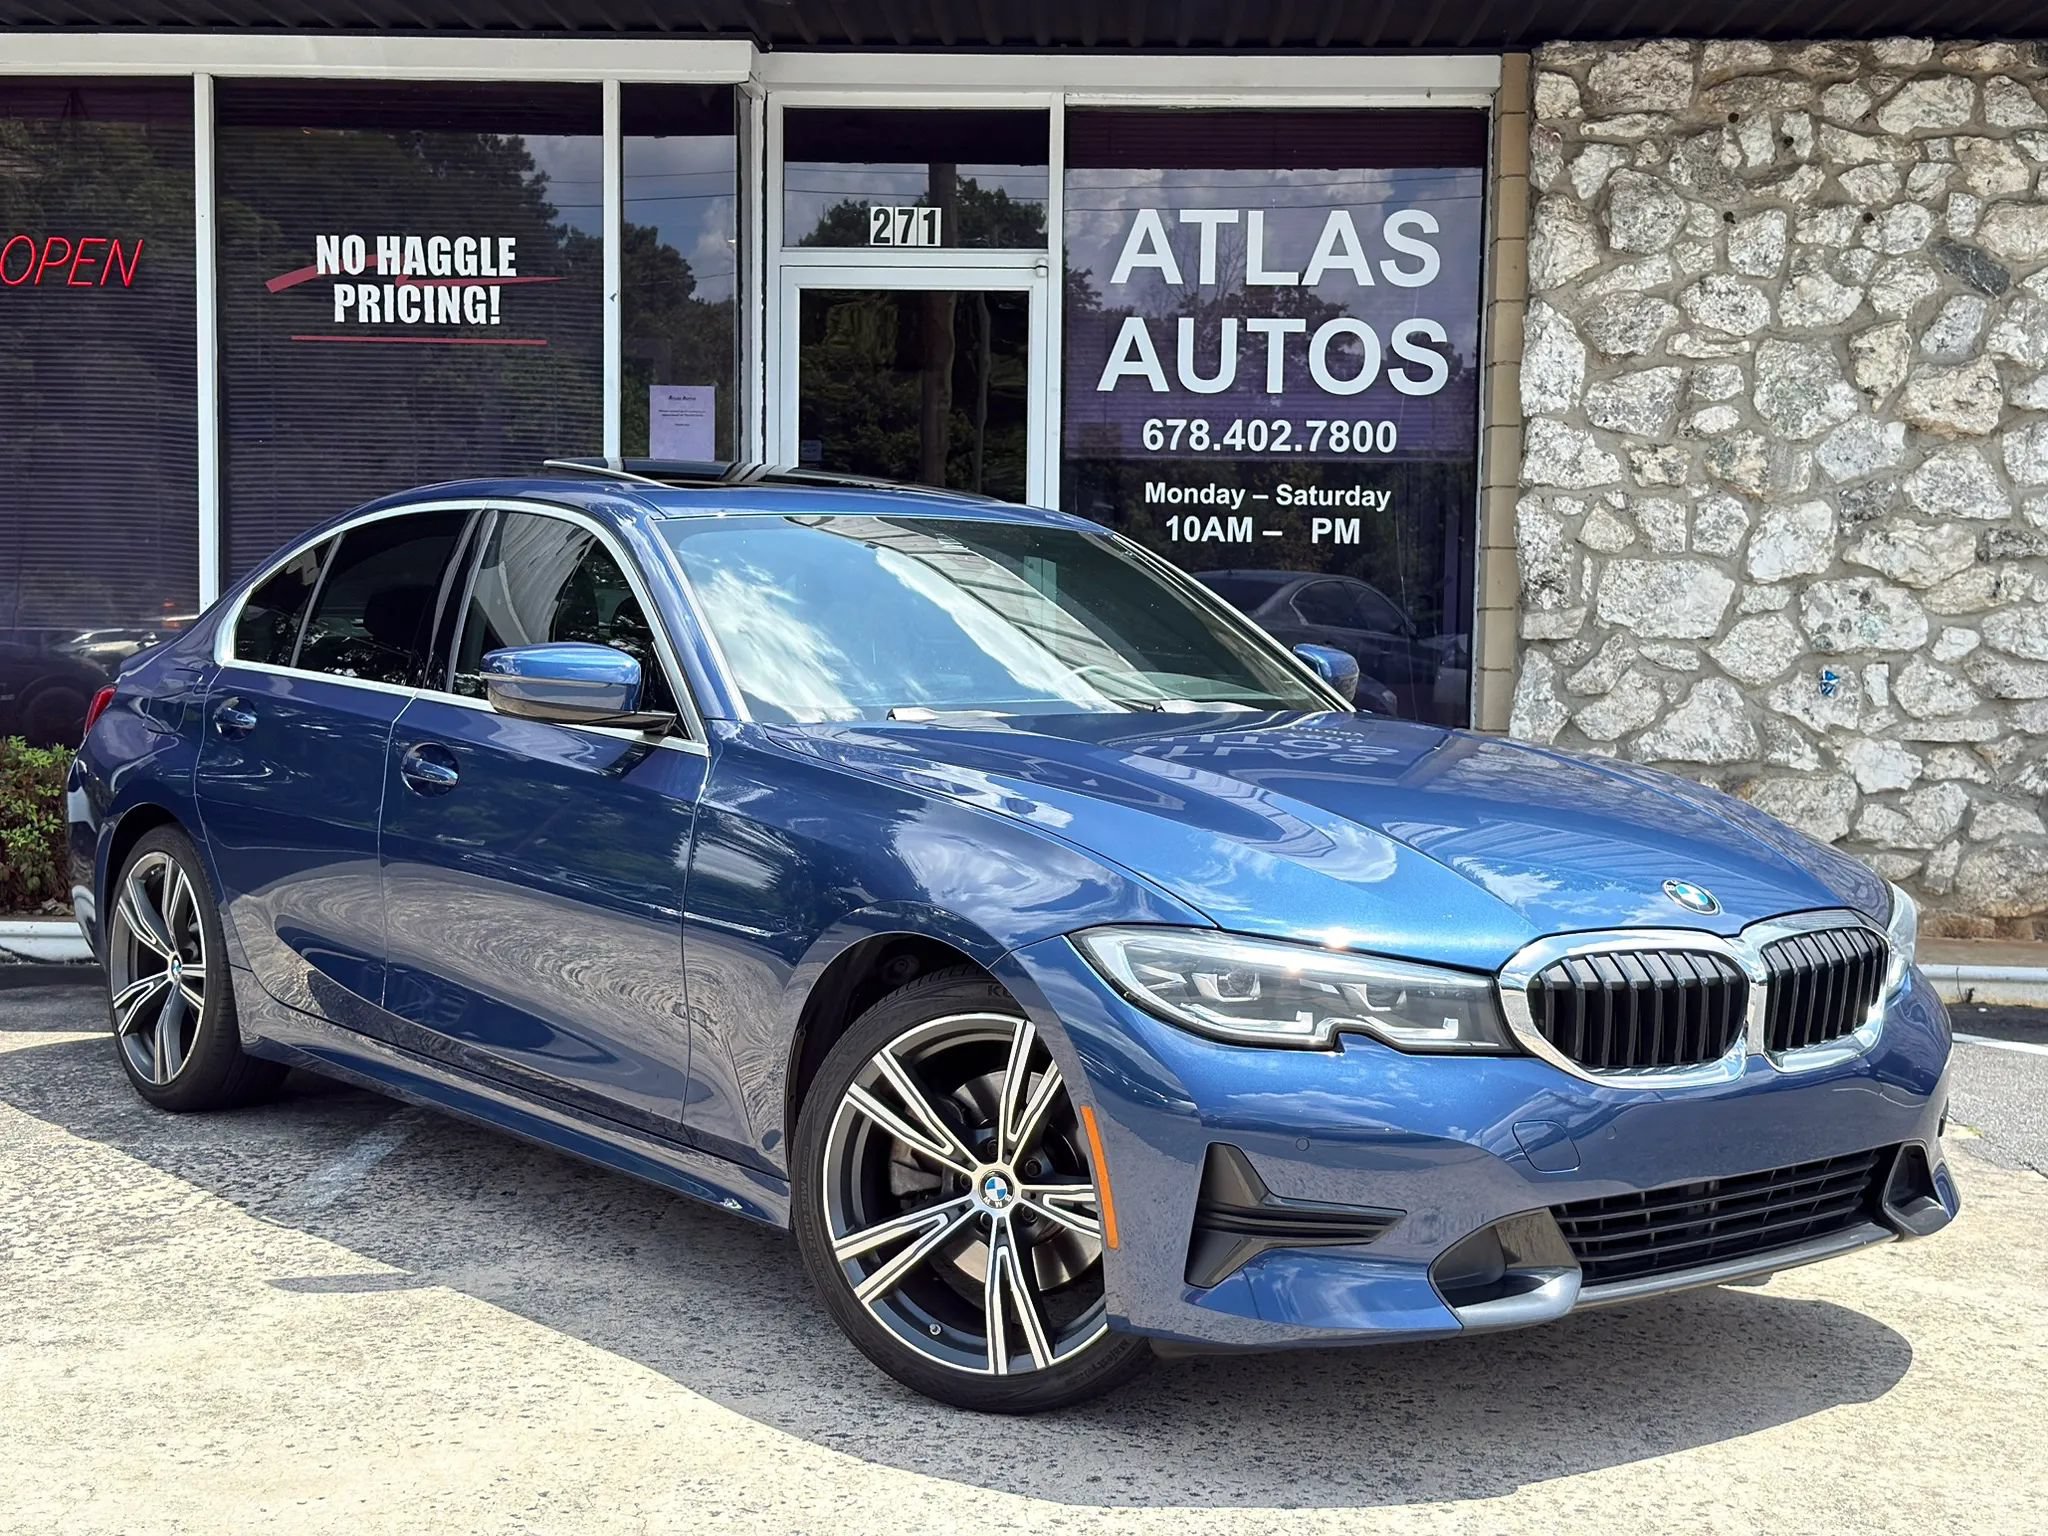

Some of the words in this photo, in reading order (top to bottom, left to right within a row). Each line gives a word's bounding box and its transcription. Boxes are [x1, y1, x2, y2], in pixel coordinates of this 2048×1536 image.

[873, 207, 936, 244] 271
[0, 234, 145, 288] OPEN
[316, 234, 366, 276] NO
[376, 235, 518, 277] HAGGLE
[1111, 208, 1441, 288] ATLAS
[334, 283, 501, 326] PRICING!
[1097, 317, 1449, 396] AUTOS
[1142, 418, 1398, 453] 678.402.7800
[1145, 481, 1246, 510] Monday
[1275, 483, 1392, 512] Saturday
[1166, 515, 1253, 543] 10AM
[1311, 517, 1361, 545] PM
